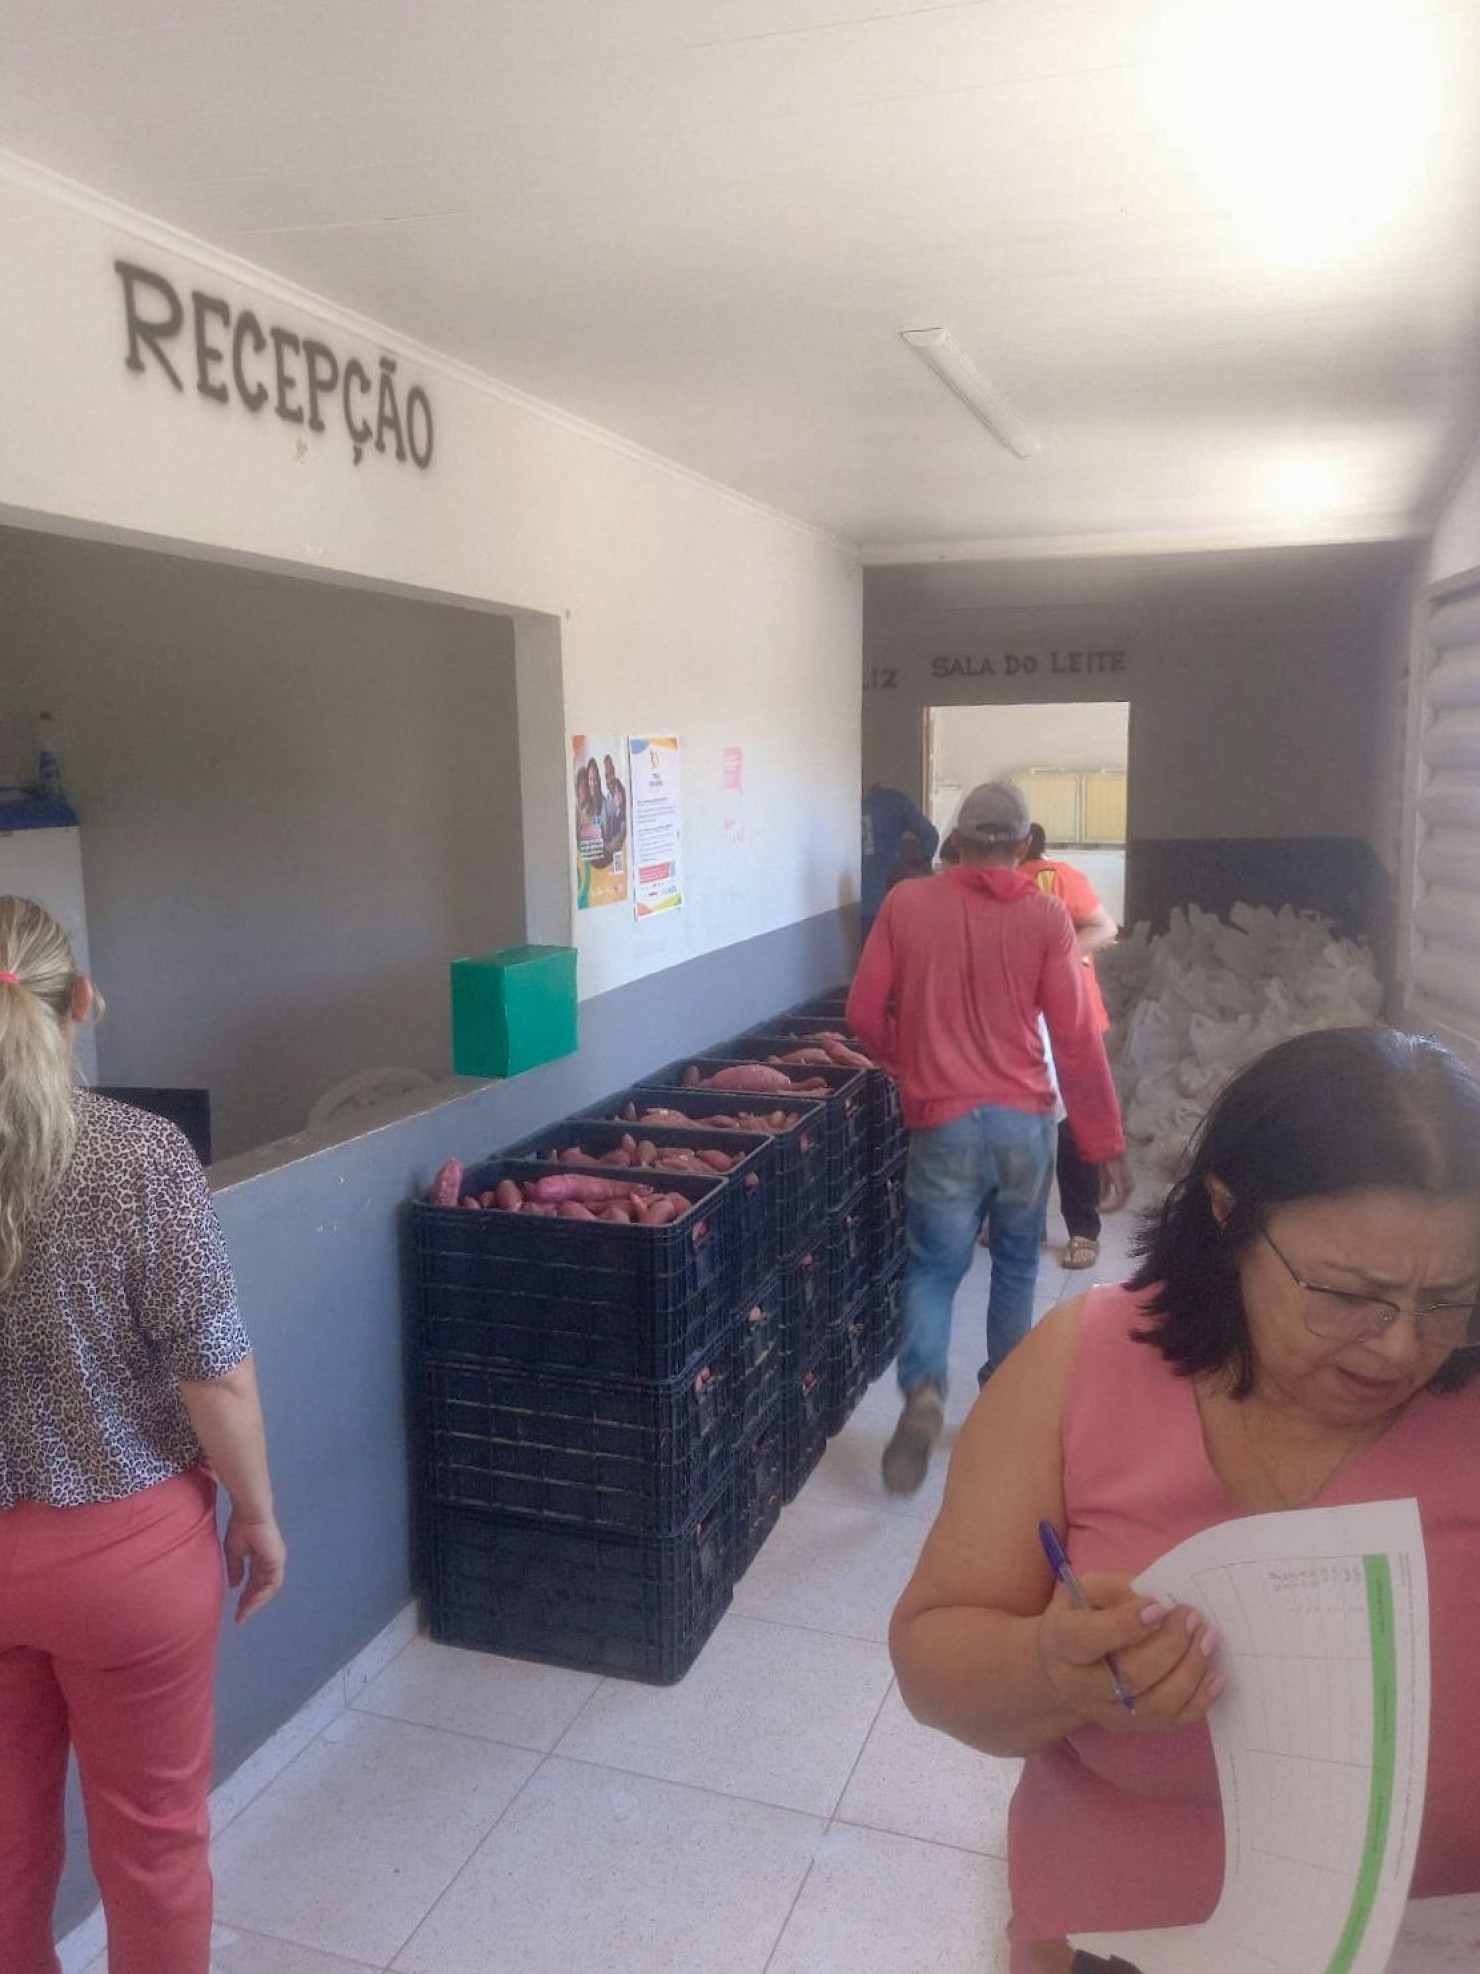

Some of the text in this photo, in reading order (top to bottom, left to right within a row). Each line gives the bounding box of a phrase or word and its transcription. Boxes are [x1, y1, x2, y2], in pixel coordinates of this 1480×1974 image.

[114, 260, 434, 469] RECEPÇÃO
[931, 650, 1127, 678] SALA DO LEITE
